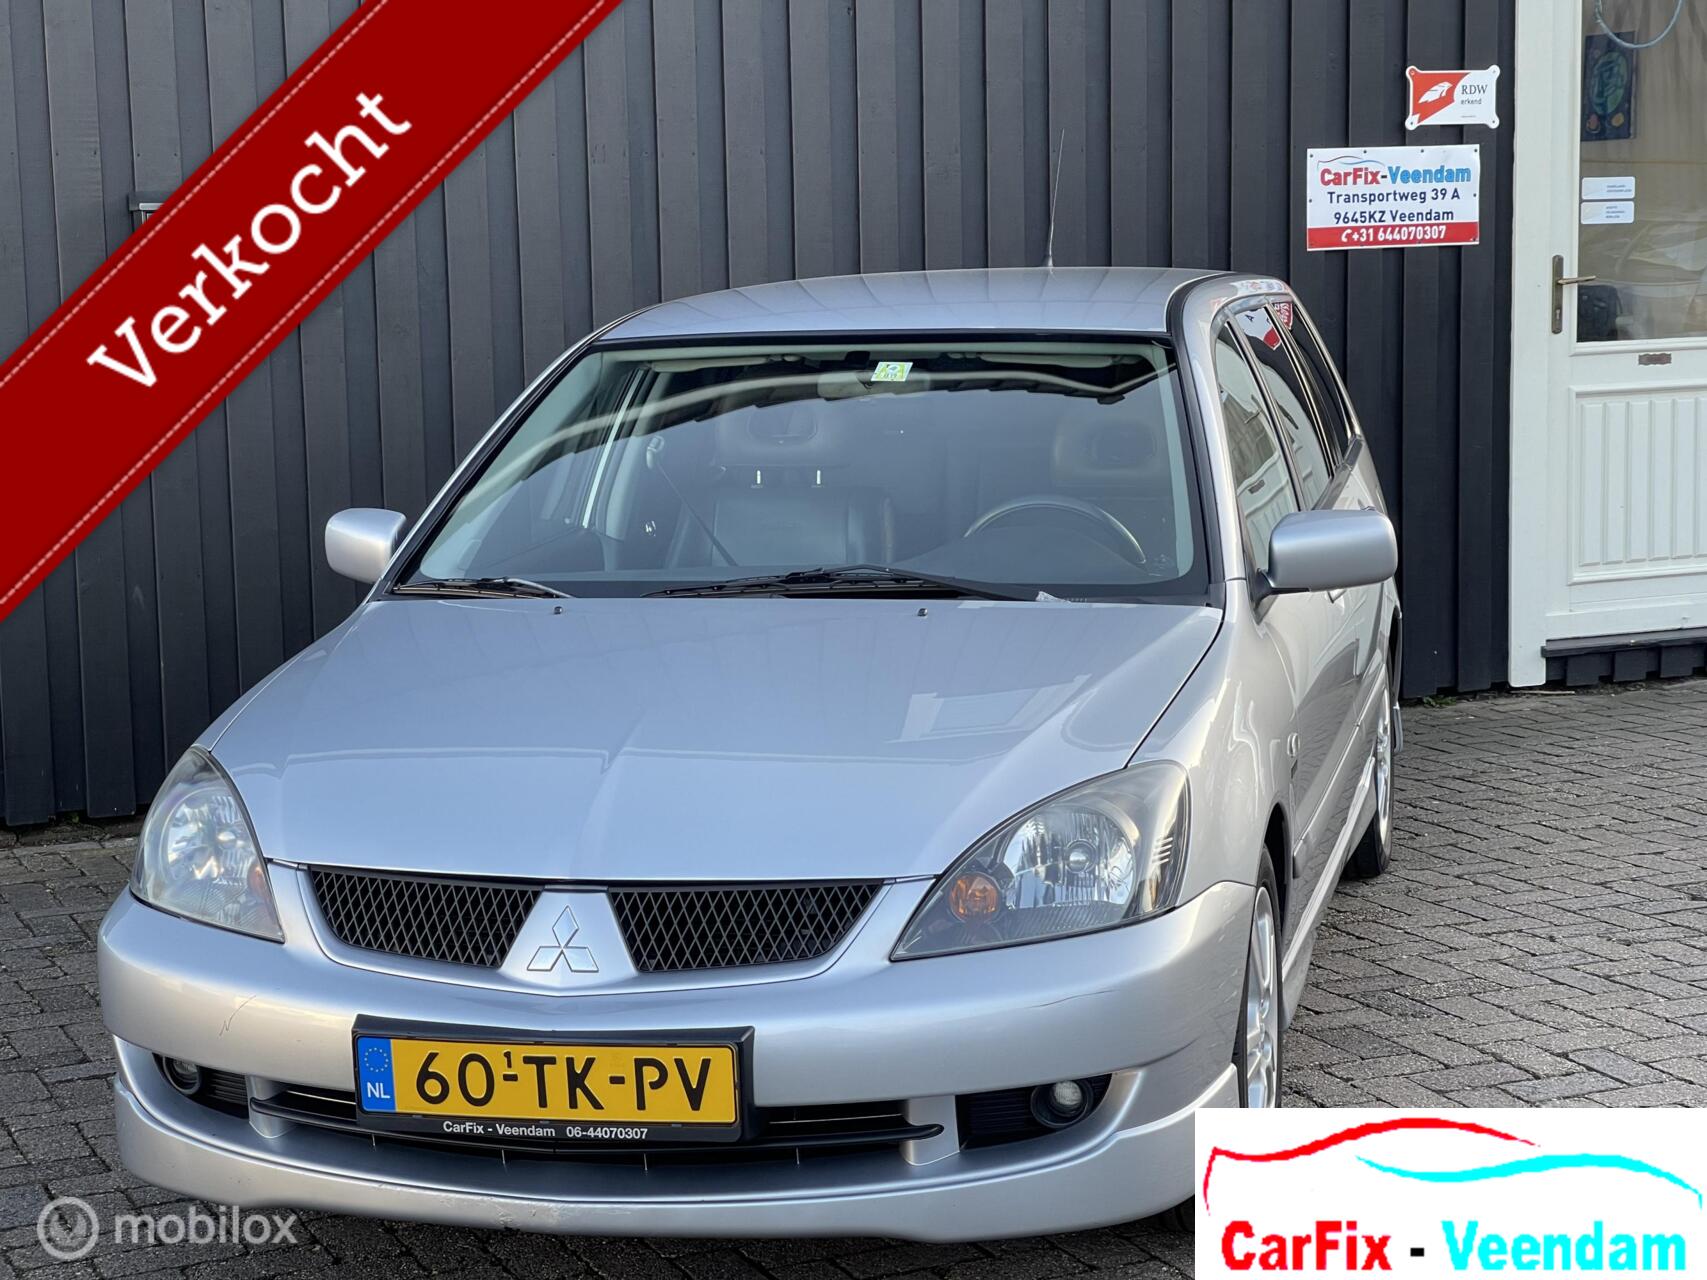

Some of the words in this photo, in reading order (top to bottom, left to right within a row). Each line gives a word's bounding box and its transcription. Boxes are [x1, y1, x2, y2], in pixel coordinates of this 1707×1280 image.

[1461, 84, 1488, 95] RDW
[1327, 190, 1427, 205] Transportweg
[1431, 188, 1447, 200] 39
[1451, 187, 1461, 200] A
[1333, 210, 1386, 225] 9645KZ
[1389, 209, 1454, 223] Veendam
[1377, 225, 1447, 242] 644070307
[367, 1082, 391, 1099] NL
[443, 1121, 484, 1134] CarFix
[496, 1124, 556, 1137] Veendam
[566, 1125, 648, 1140] 06-44070307
